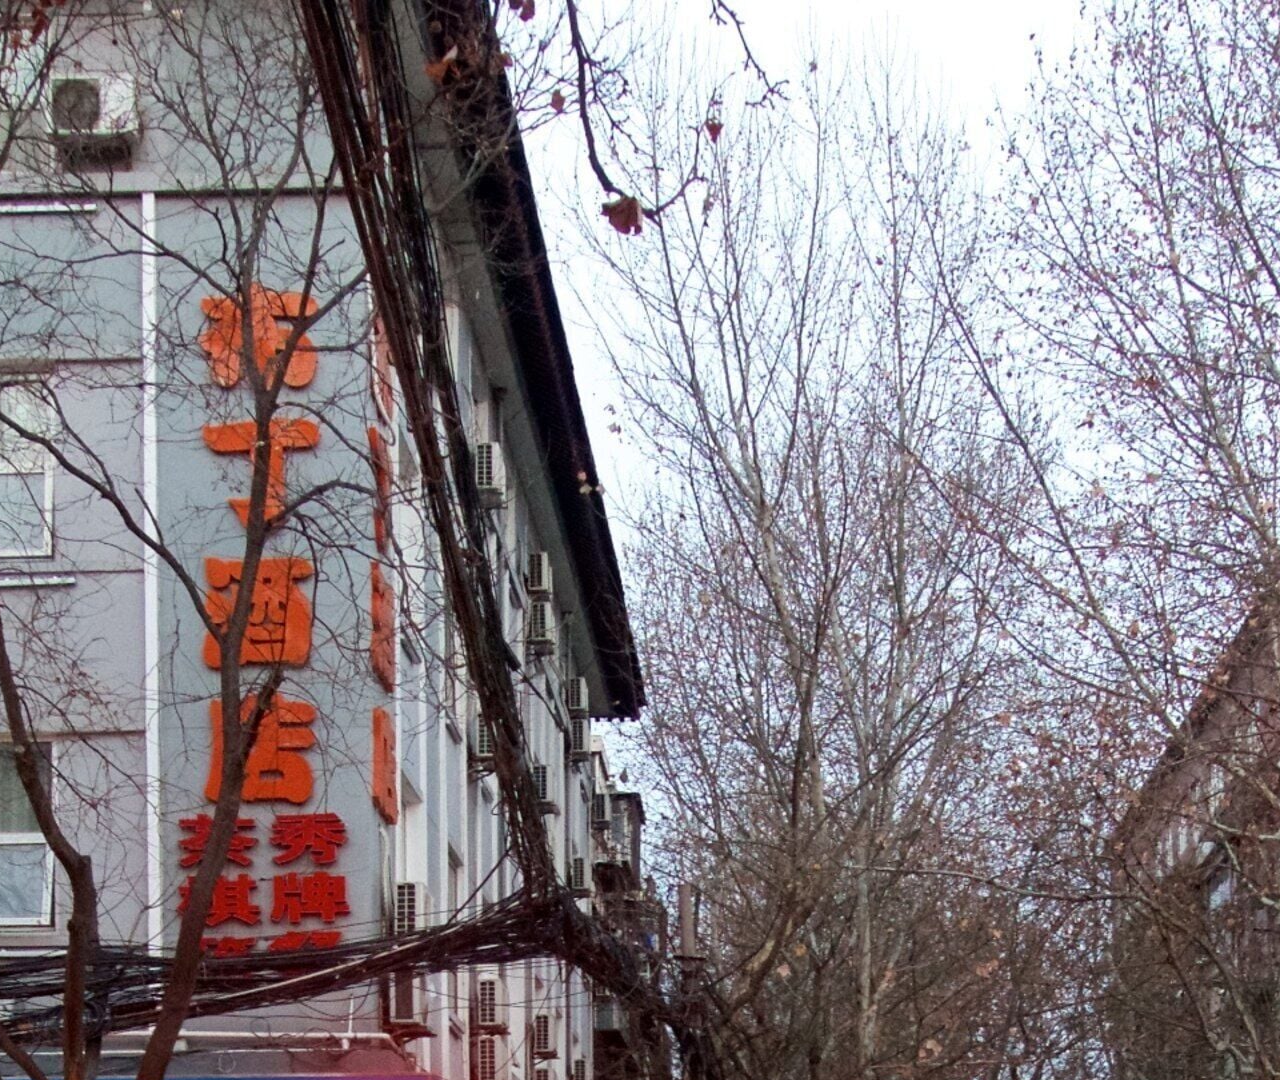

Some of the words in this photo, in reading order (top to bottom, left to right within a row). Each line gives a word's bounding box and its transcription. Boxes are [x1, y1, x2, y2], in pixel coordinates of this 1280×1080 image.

[198, 282, 320, 804] 布丁酒店
[177, 871, 350, 925] 棋牌
